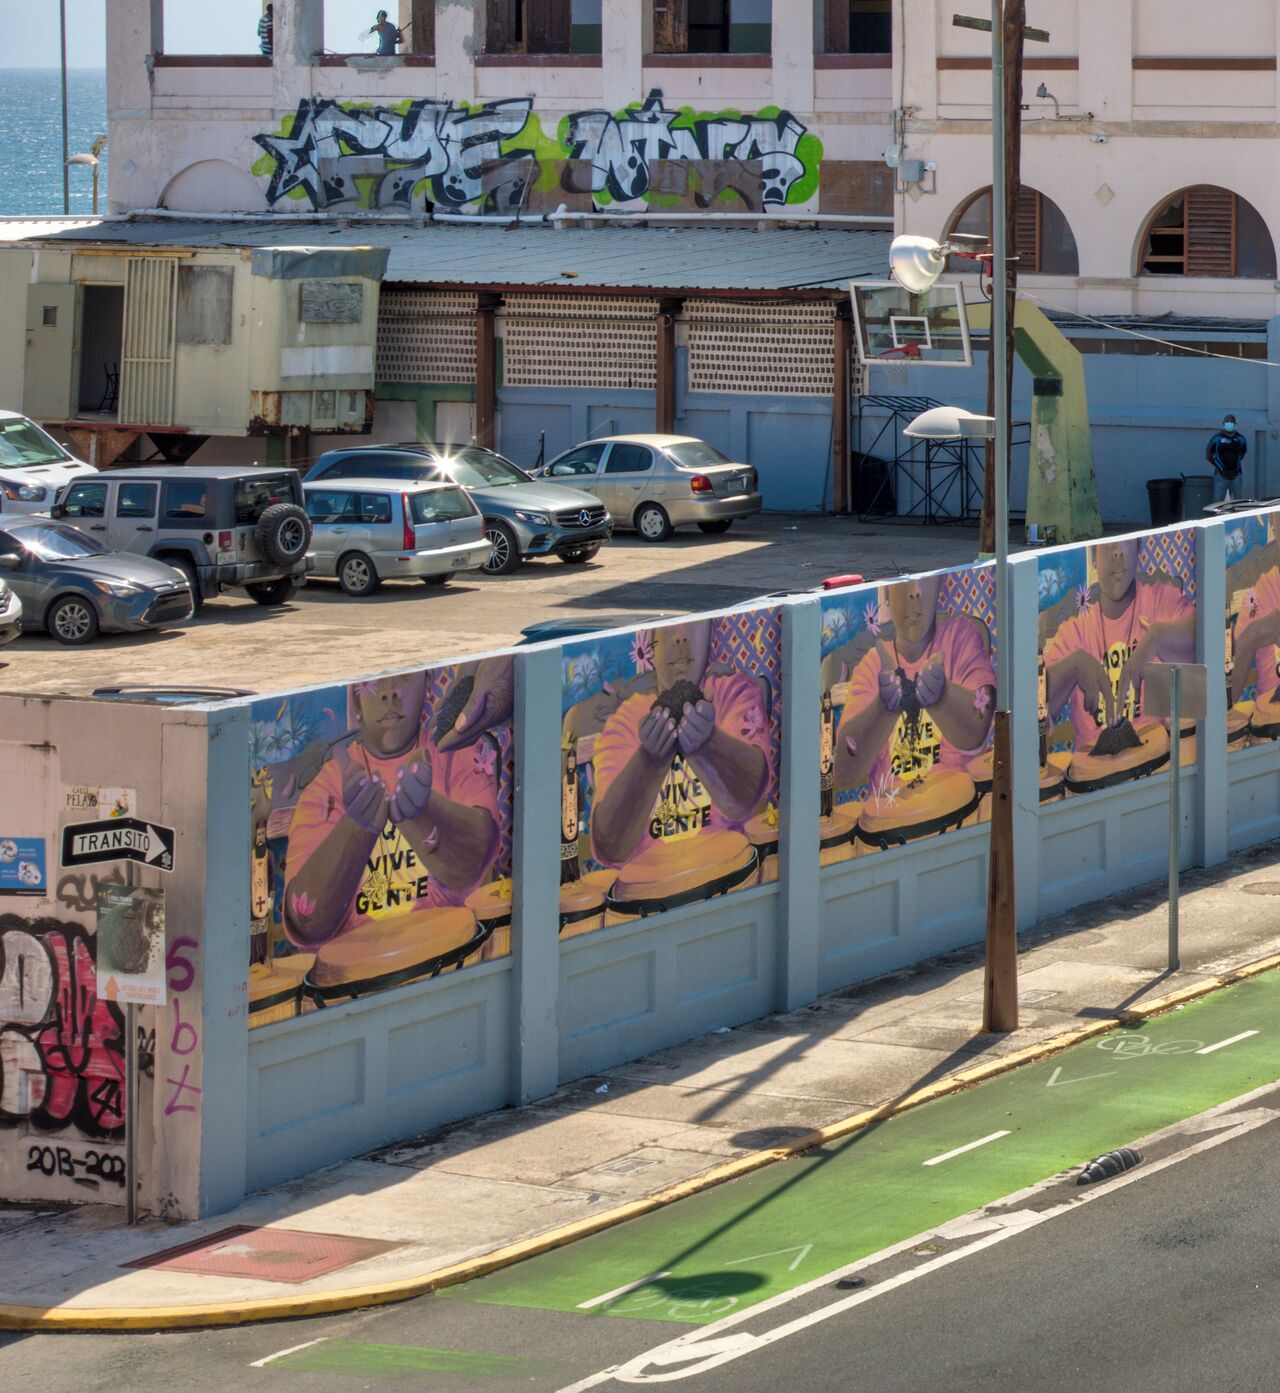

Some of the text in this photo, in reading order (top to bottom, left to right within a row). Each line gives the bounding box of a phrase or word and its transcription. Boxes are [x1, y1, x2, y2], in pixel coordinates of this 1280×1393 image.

[660, 777, 702, 804] VIVE
[648, 804, 712, 839] GENTE
[79, 829, 150, 853] TRANSITO
[367, 848, 417, 875] VIVE
[355, 875, 429, 915] GENTE
